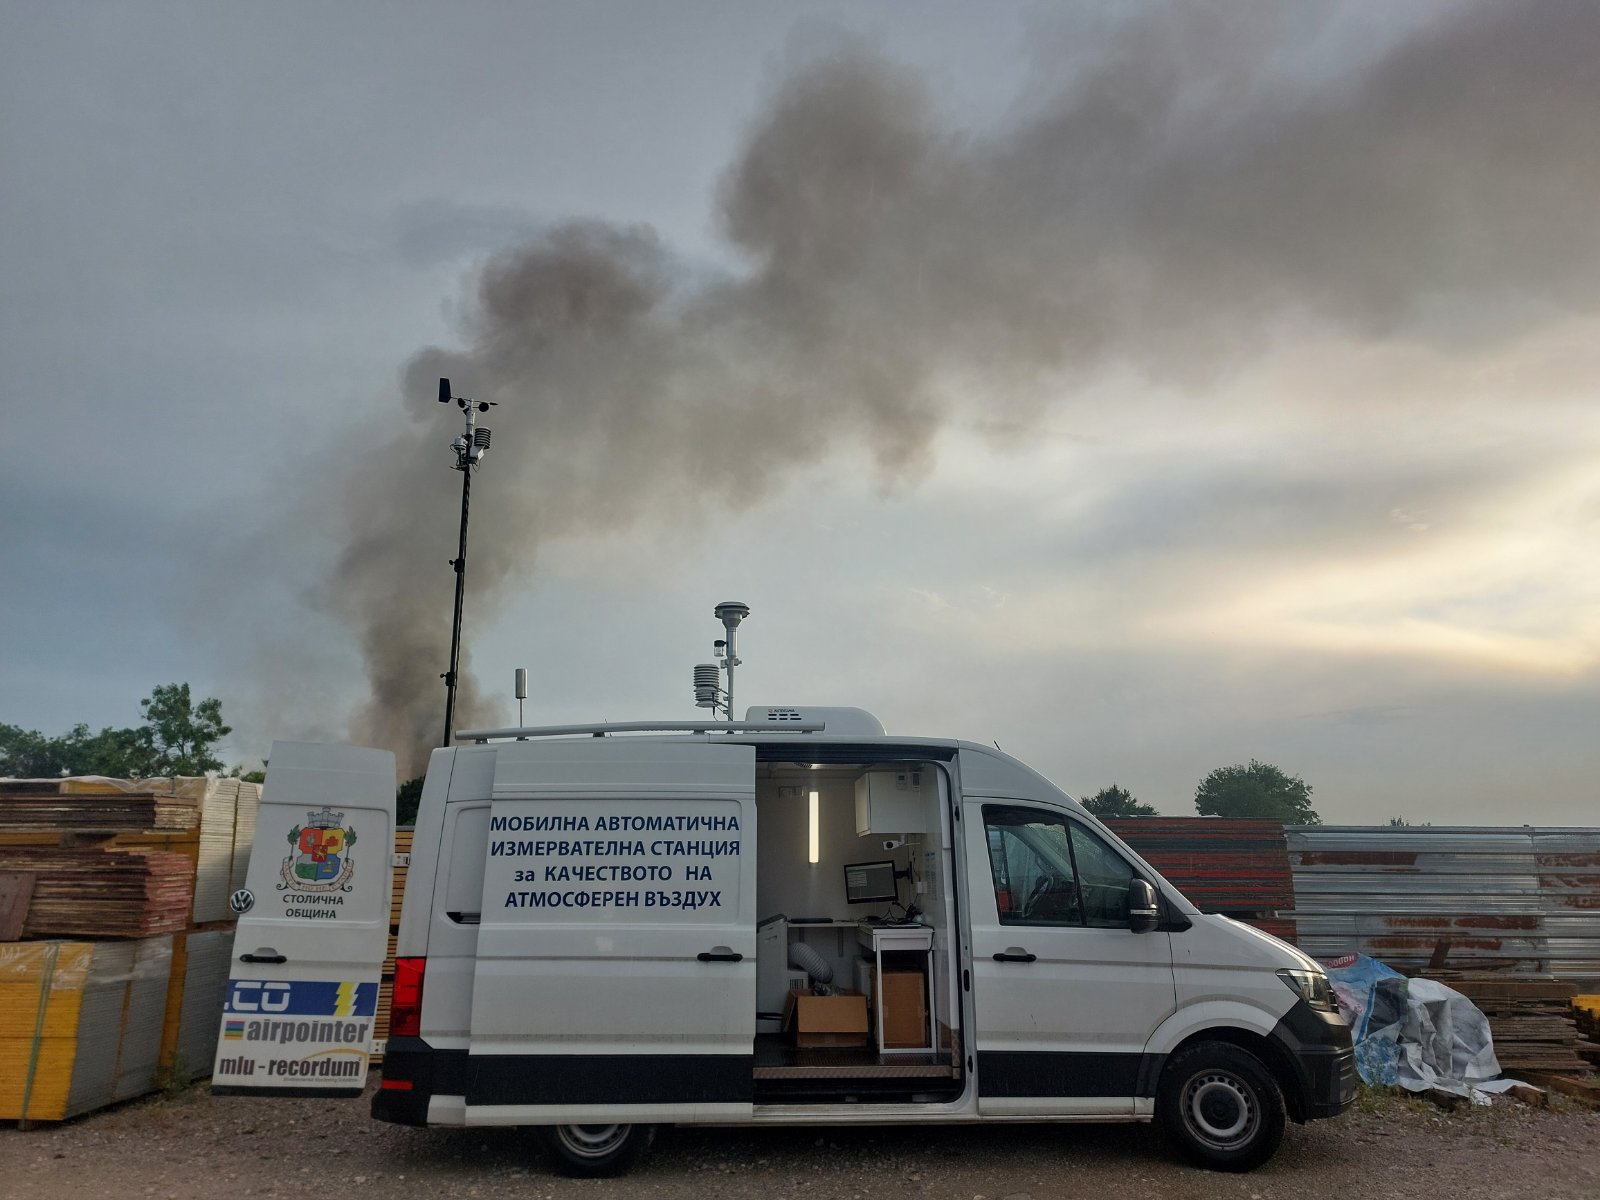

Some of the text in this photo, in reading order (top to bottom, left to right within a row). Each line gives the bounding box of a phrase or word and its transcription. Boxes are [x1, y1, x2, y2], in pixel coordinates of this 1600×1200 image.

[490, 816, 740, 831] МОБИЛНА АВТОМАТИЧНА
[490, 840, 740, 859] ИЗМЕРВАТЕЛНА СТАНЦИЯ
[514, 866, 712, 882] за КАЧЕСТВОТО НА
[283, 894, 344, 905] СТОЛИЧНА
[505, 891, 721, 909] АТМОСФЕРЕН ВЪЗДУХ
[286, 908, 336, 919] ОБЩИНА
[224, 981, 291, 1012] CO
[246, 1019, 369, 1044] airpointer
